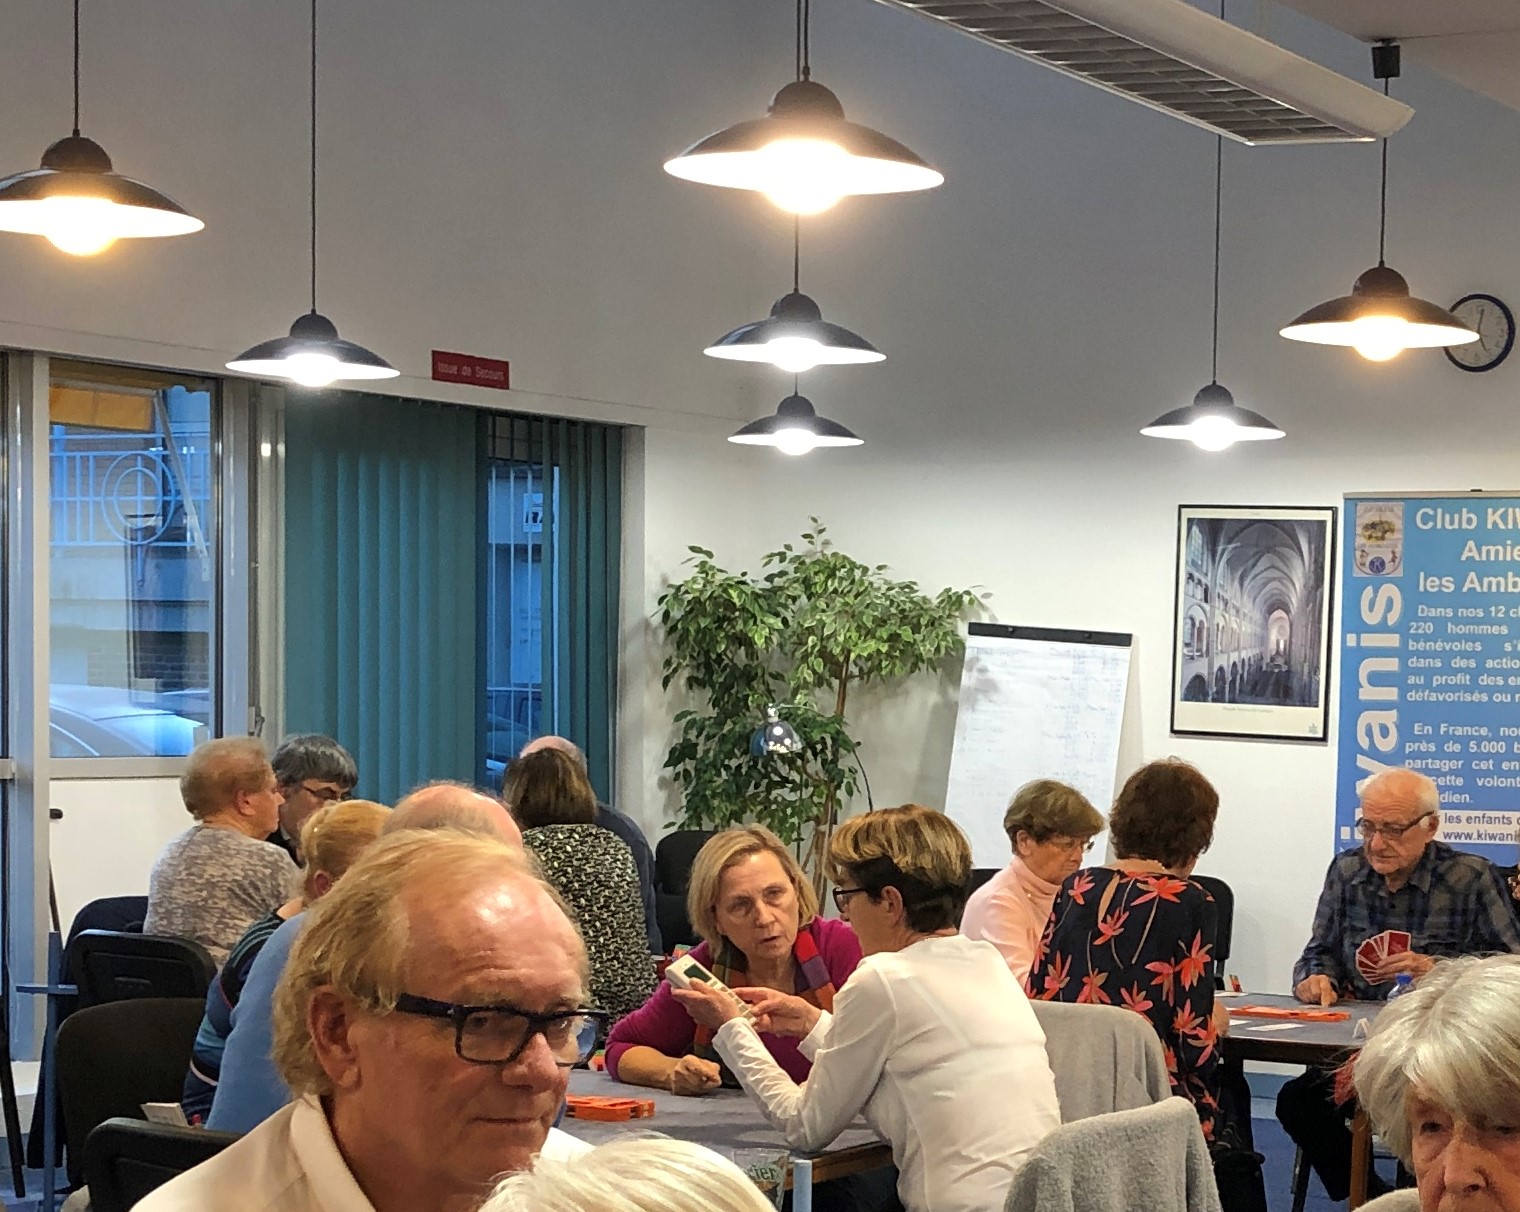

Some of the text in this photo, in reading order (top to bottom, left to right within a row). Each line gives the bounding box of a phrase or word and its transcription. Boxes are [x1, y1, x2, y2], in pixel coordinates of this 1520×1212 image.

[1415, 507, 1478, 530] Club
[1418, 571, 1456, 593] les
[1417, 604, 1454, 617] Dans
[1457, 607, 1484, 618] nos
[1489, 605, 1506, 618] 12
[1408, 622, 1434, 634] 220
[1447, 622, 1509, 635] hommes
[1408, 638, 1482, 652] bénévoles
[1407, 656, 1443, 668] dans
[1450, 656, 1477, 668] des
[1406, 675, 1425, 685] au
[1432, 672, 1471, 687] profit
[1478, 673, 1505, 686] des
[1406, 689, 1489, 703] défavorisés
[1492, 693, 1511, 703] ou
[1413, 722, 1433, 735] En
[1439, 723, 1492, 738] France,
[1405, 740, 1436, 753] près
[1443, 740, 1462, 753] de
[1468, 741, 1506, 754] 5.000
[1404, 758, 1464, 773] partager
[1471, 759, 1495, 771] cet
[1444, 812, 1463, 825] les
[1465, 813, 1513, 826] enfants
